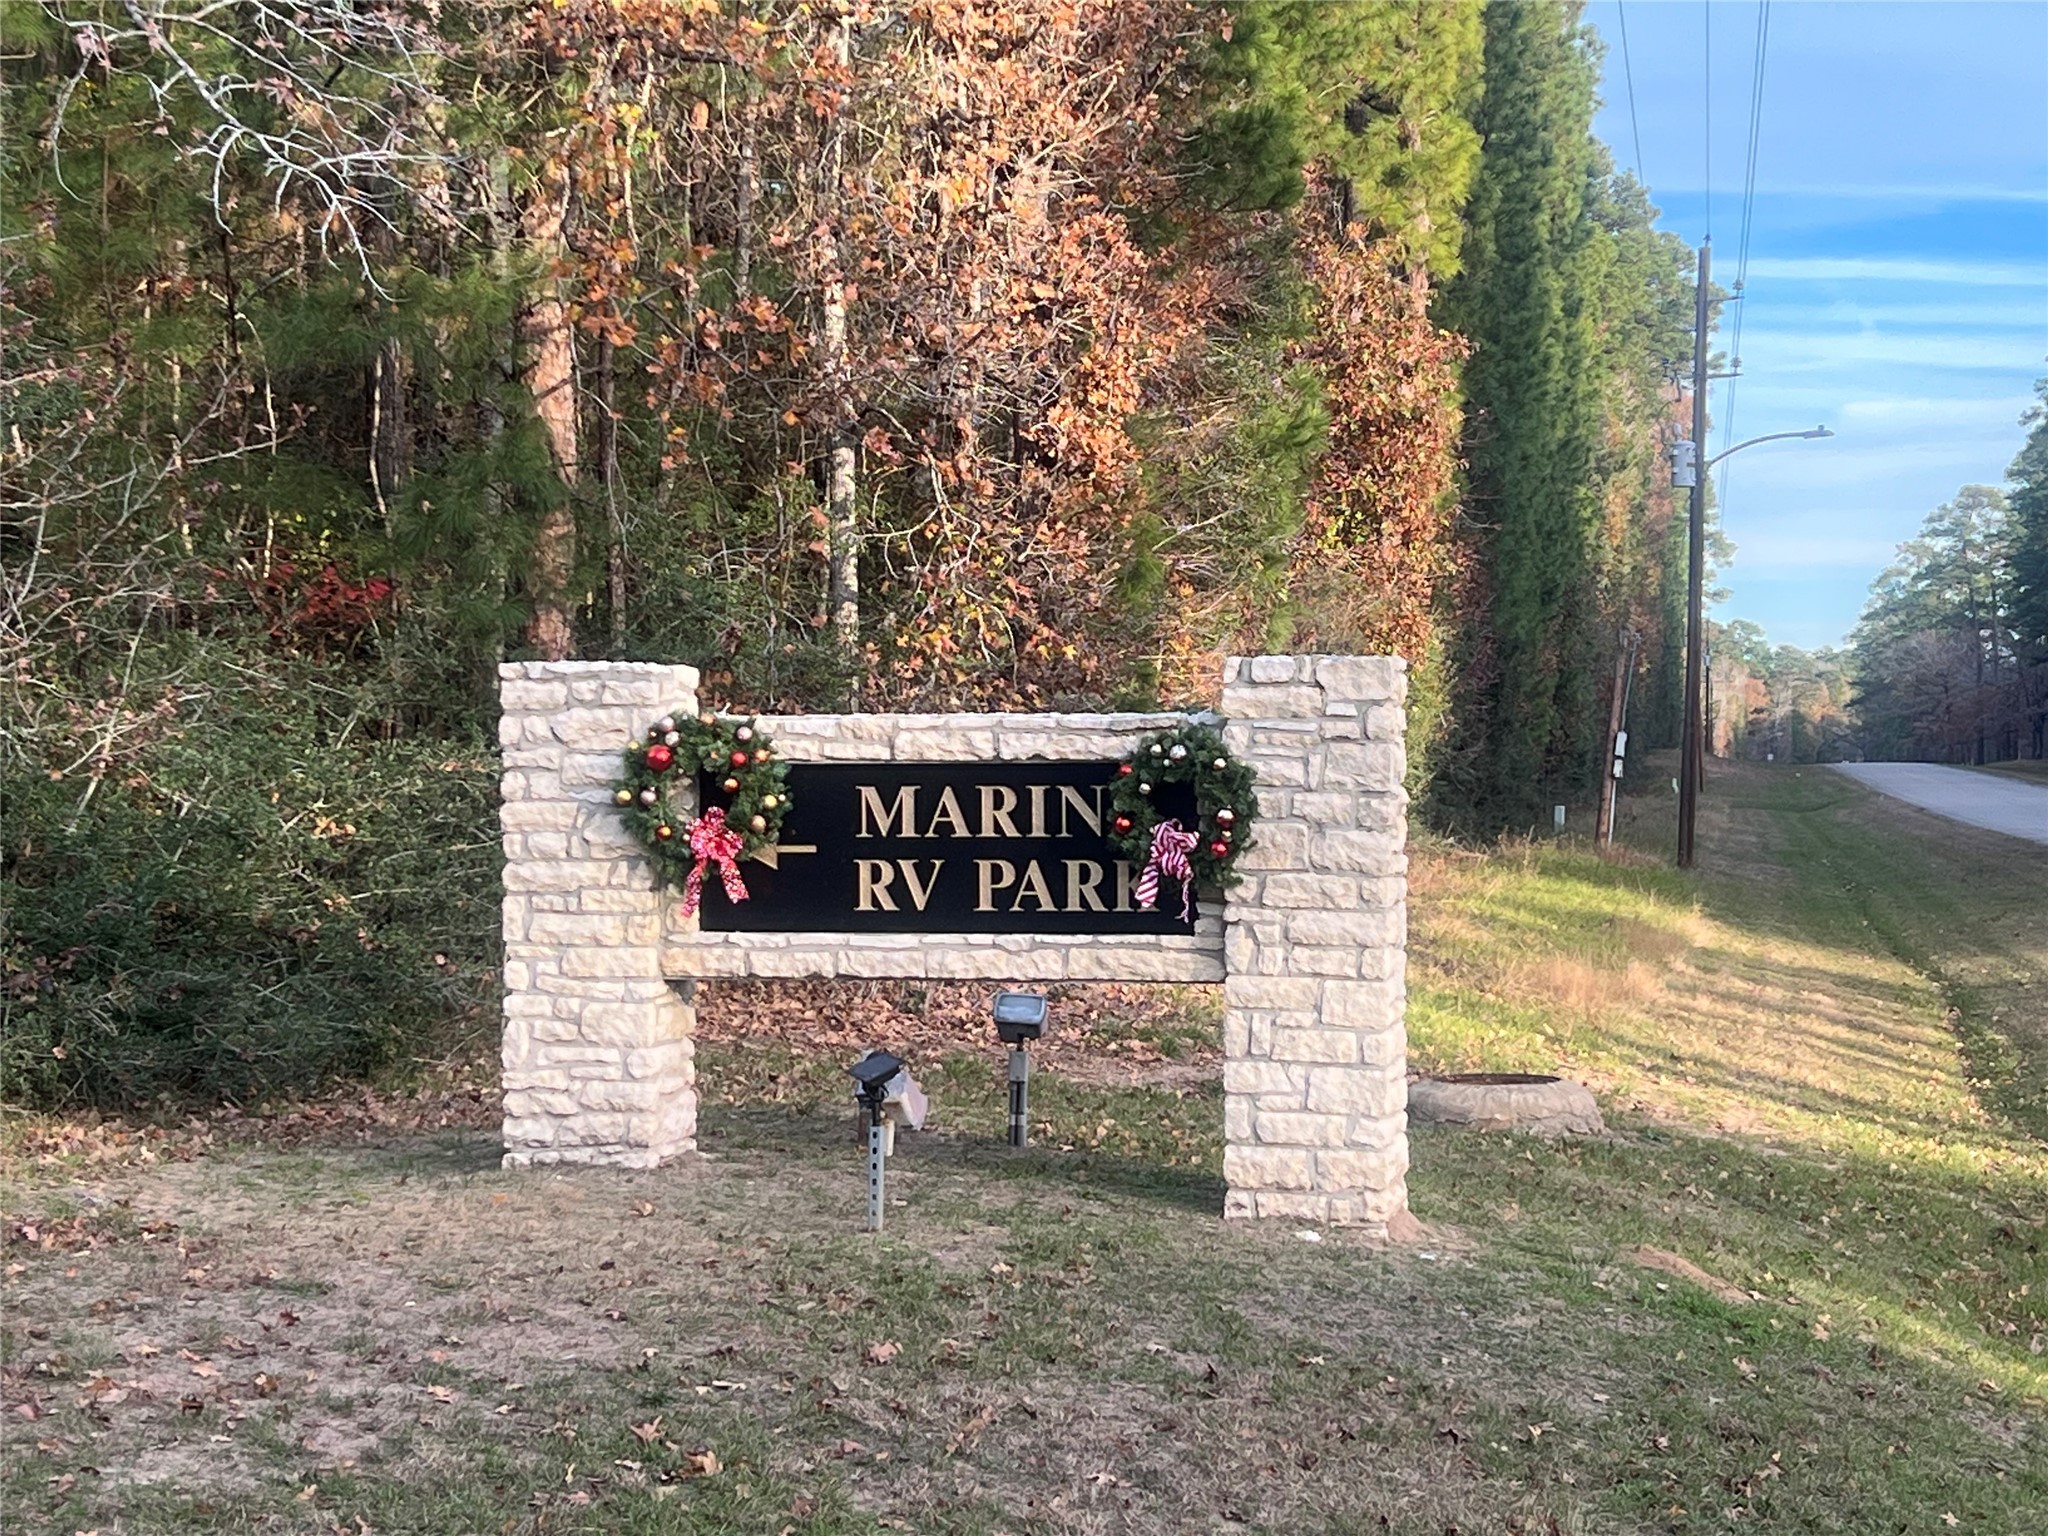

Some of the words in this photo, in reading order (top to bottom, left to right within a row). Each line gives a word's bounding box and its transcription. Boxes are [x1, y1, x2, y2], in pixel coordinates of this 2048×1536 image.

[854, 785, 1107, 838] MARIN
[853, 859, 943, 911] RV
[973, 859, 1161, 912] PARK
